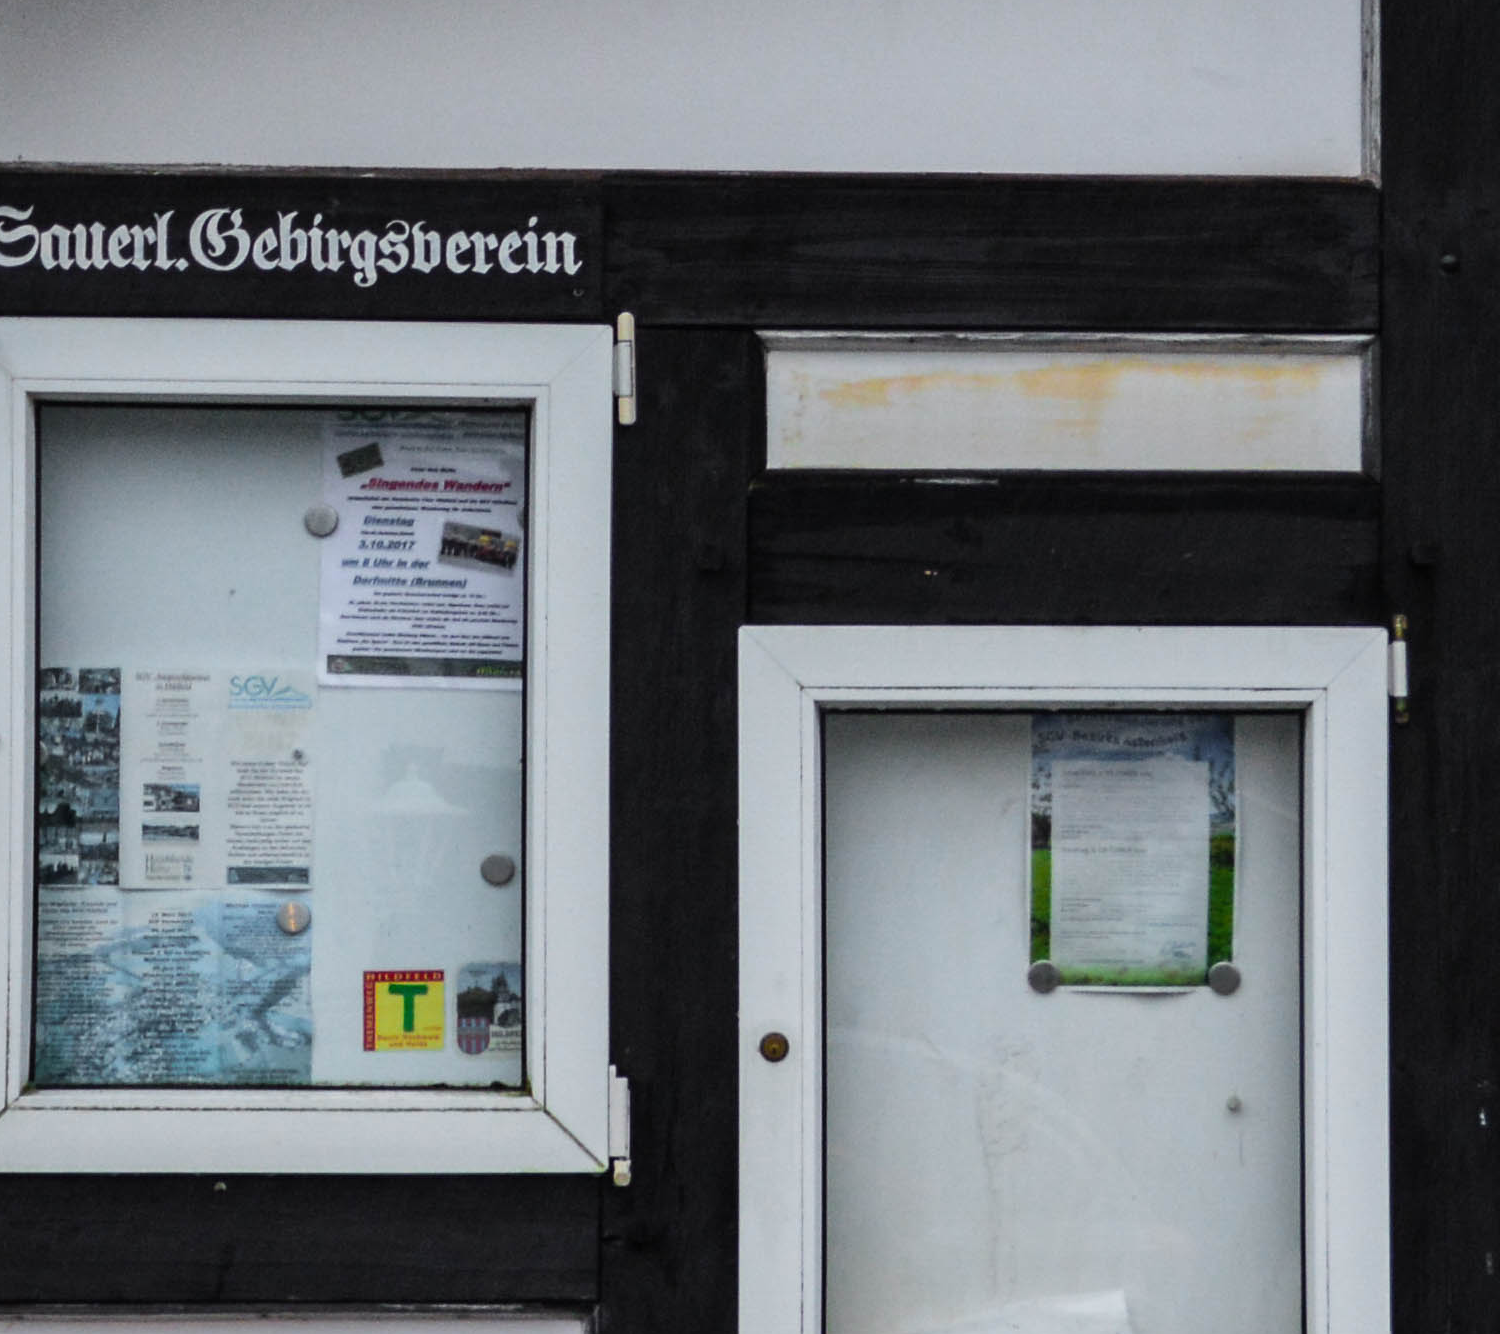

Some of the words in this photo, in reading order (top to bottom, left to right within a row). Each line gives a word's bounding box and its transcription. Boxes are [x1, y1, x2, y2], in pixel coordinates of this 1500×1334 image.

[190, 207, 582, 287] Gebirgsverein
[230, 675, 278, 697] SGV
[388, 983, 429, 1033] T
